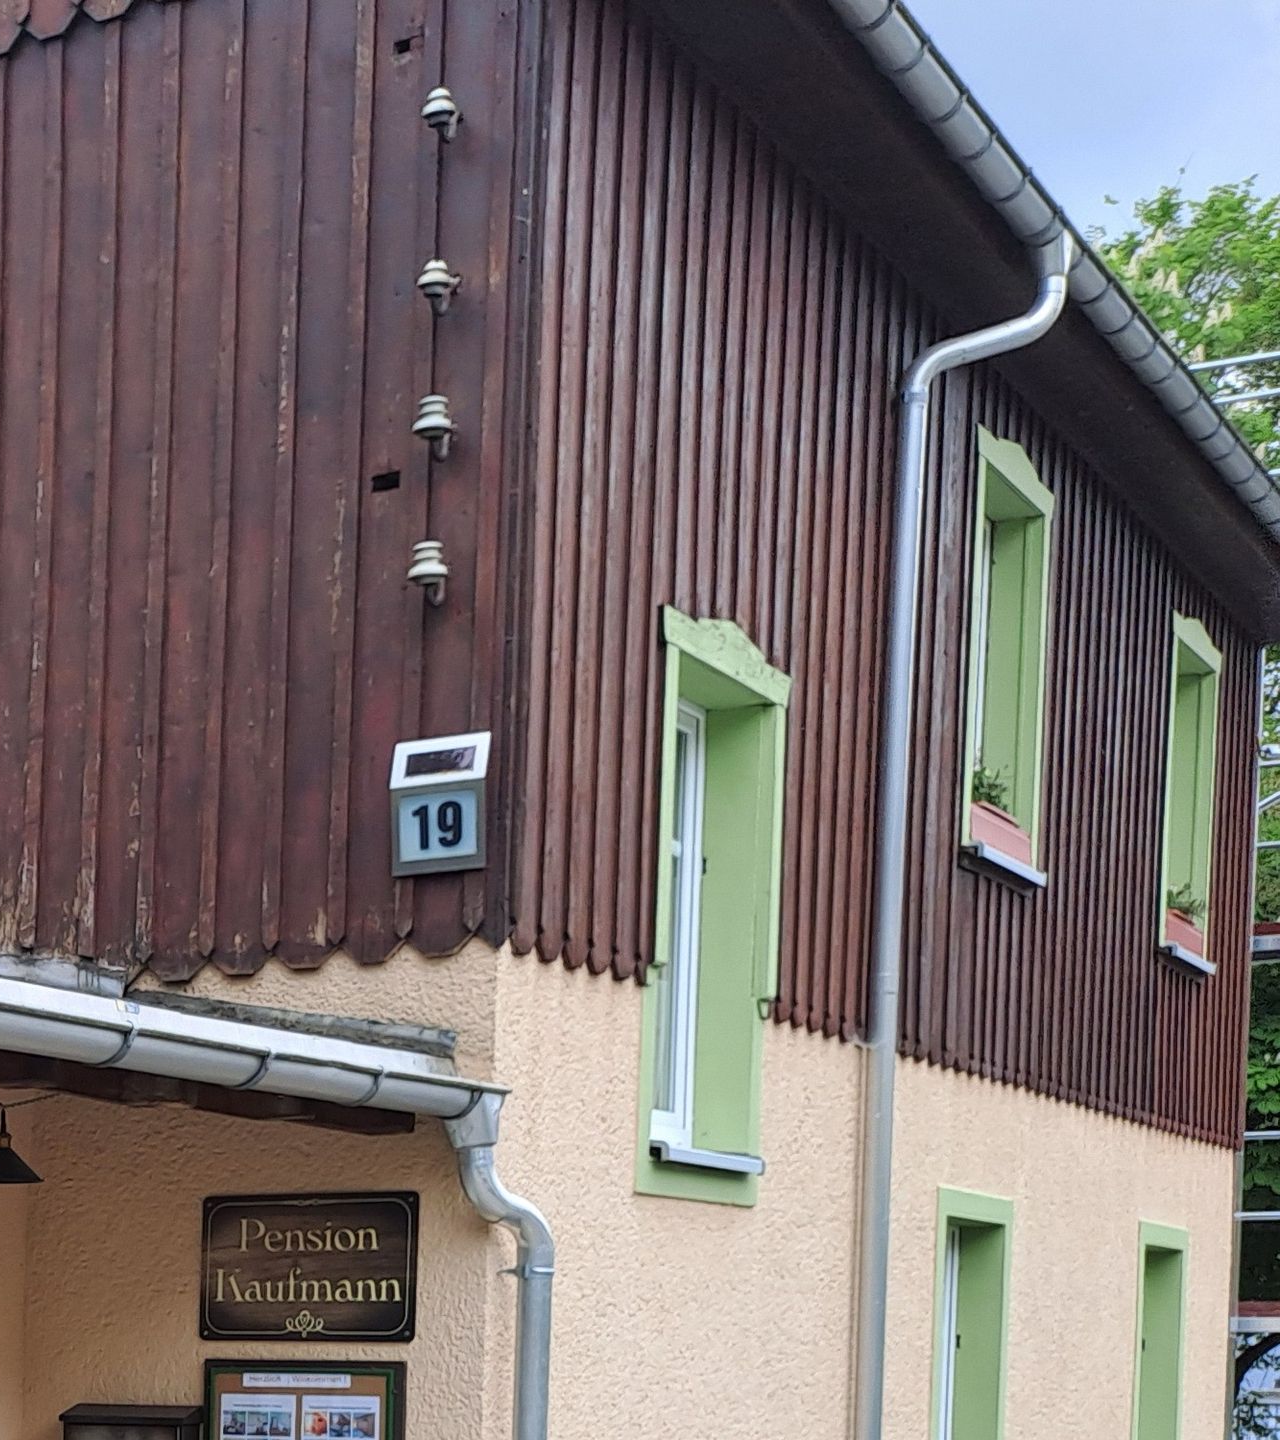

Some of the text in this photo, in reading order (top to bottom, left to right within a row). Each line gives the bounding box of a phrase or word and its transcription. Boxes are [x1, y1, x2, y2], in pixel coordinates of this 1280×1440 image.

[411, 800, 462, 851] 19
[240, 1217, 379, 1252] Pension
[215, 1267, 402, 1302] Kaufmann
